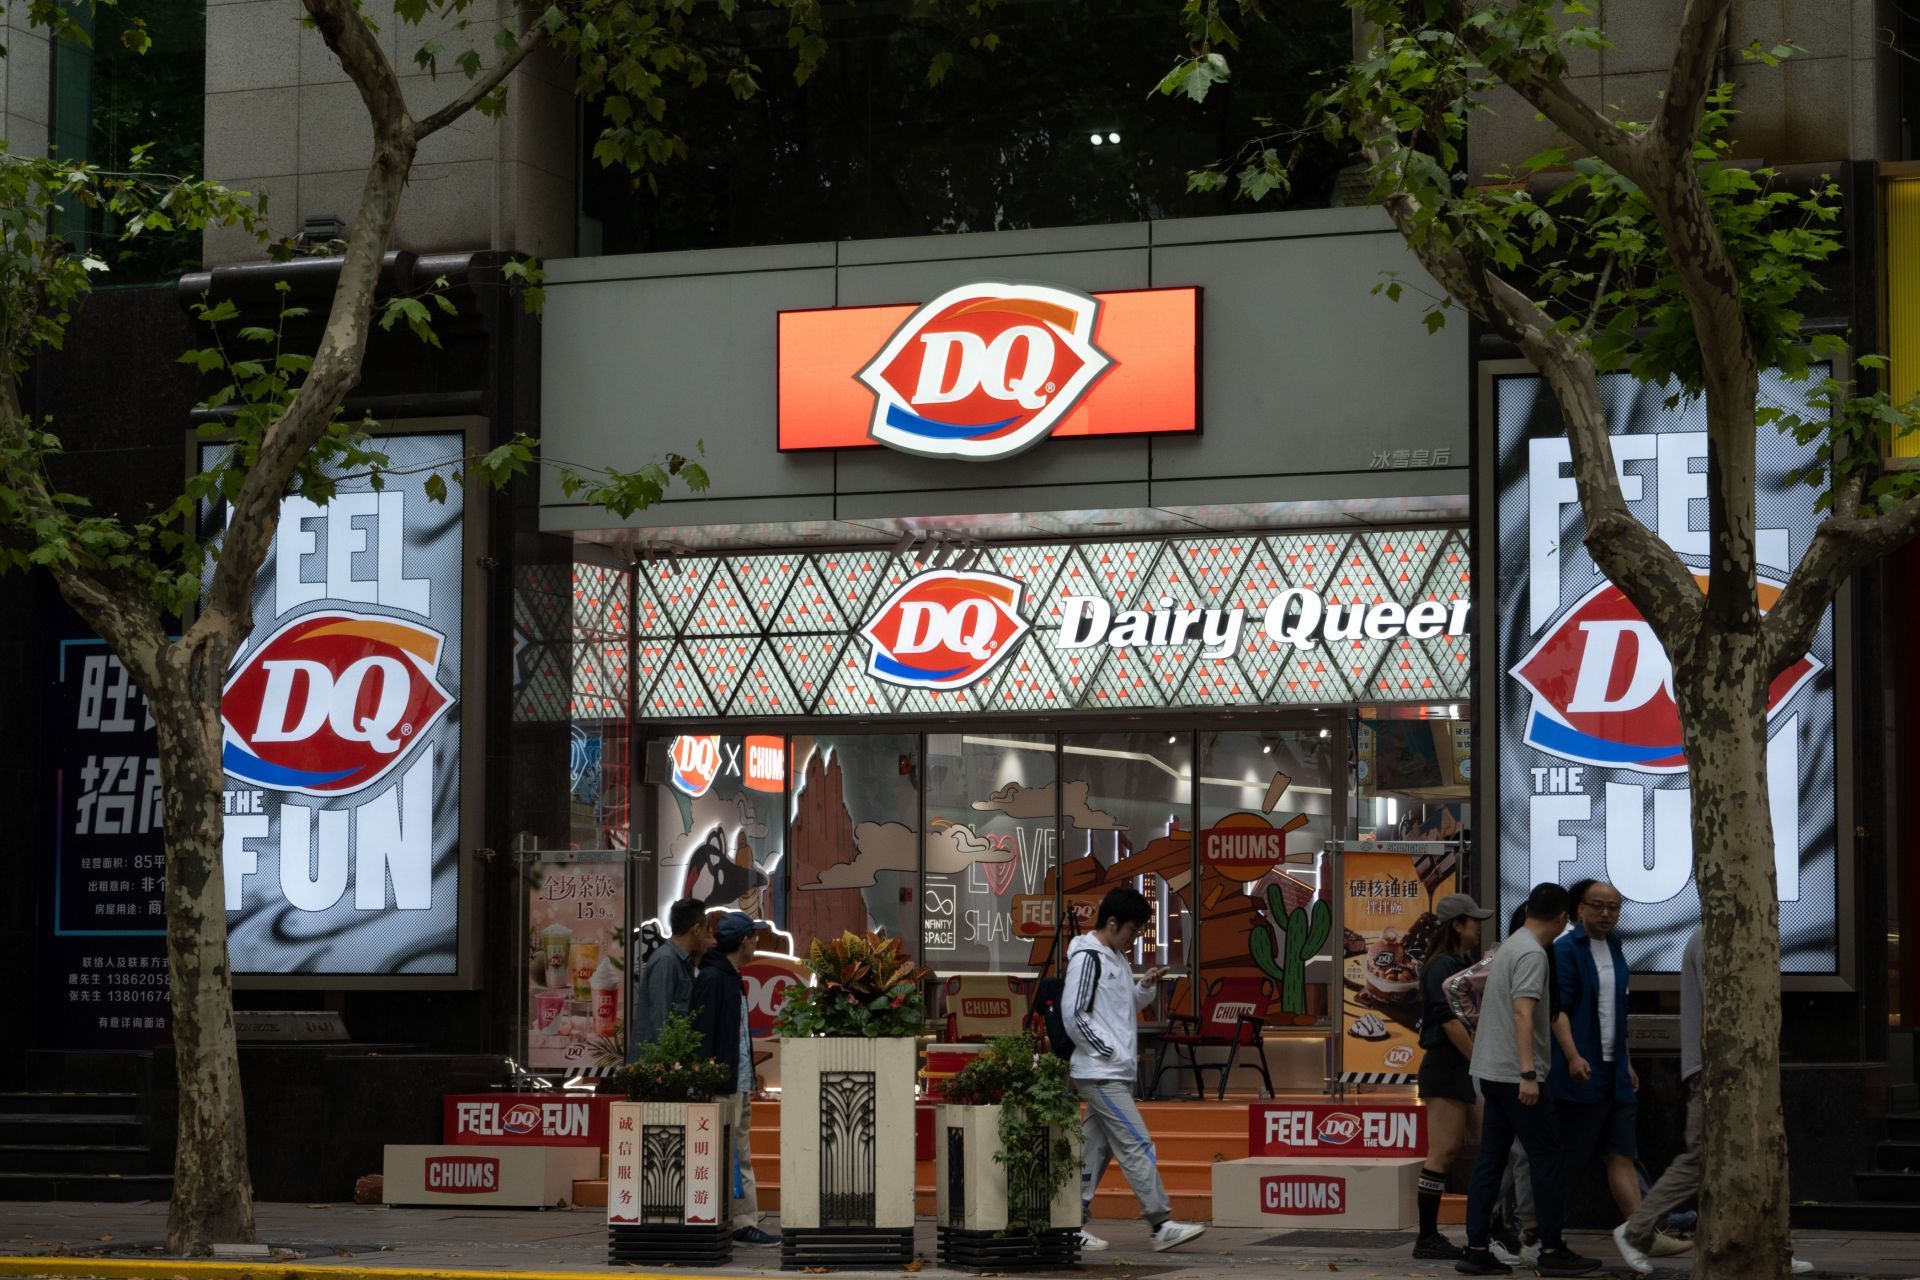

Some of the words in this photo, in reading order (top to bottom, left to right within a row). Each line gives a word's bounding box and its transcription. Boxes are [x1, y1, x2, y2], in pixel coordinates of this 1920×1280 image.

[911, 325, 1056, 409] DQ
[1369, 448, 1451, 469] 冰雪皇后
[1528, 431, 1790, 637] FE
[226, 491, 431, 624] EEL
[892, 598, 992, 660] DQ
[1055, 596, 1245, 659] Dairy
[1566, 620, 1680, 713] D
[77, 654, 156, 733] 旺
[251, 655, 412, 753] DQ
[679, 735, 714, 780] DQ
[750, 745, 785, 781] CHUM
[1530, 766, 1584, 793] THE
[223, 791, 264, 813] THE
[223, 741, 434, 912] FUN
[1207, 834, 1280, 860] CHUMS
[539, 875, 616, 900] 全场茶饮
[95, 900, 167, 916] 房屋用途：商
[1022, 901, 1065, 930] FEE
[925, 919, 953, 930] NFINITY
[925, 932, 953, 944] SPACE
[69, 990, 101, 1001] 张先生
[965, 1000, 1008, 1015] CHUMS
[568, 1047, 584, 1057] DQ
[1389, 1051, 1409, 1062] DQ
[457, 1103, 504, 1136] FEEL
[510, 1111, 536, 1126] DQ
[542, 1103, 589, 1137] FUN
[543, 1127, 556, 1136] THE
[1264, 1111, 1318, 1147] FEEL
[1325, 1120, 1354, 1136] DQ
[1362, 1112, 1417, 1149] FUN
[1363, 1138, 1378, 1147] THE
[618, 1116, 634, 1205] 诚信服务
[693, 1116, 709, 1206] 文明旅游
[429, 1162, 495, 1187] CHUMS
[1265, 1182, 1340, 1208] CHUMS
